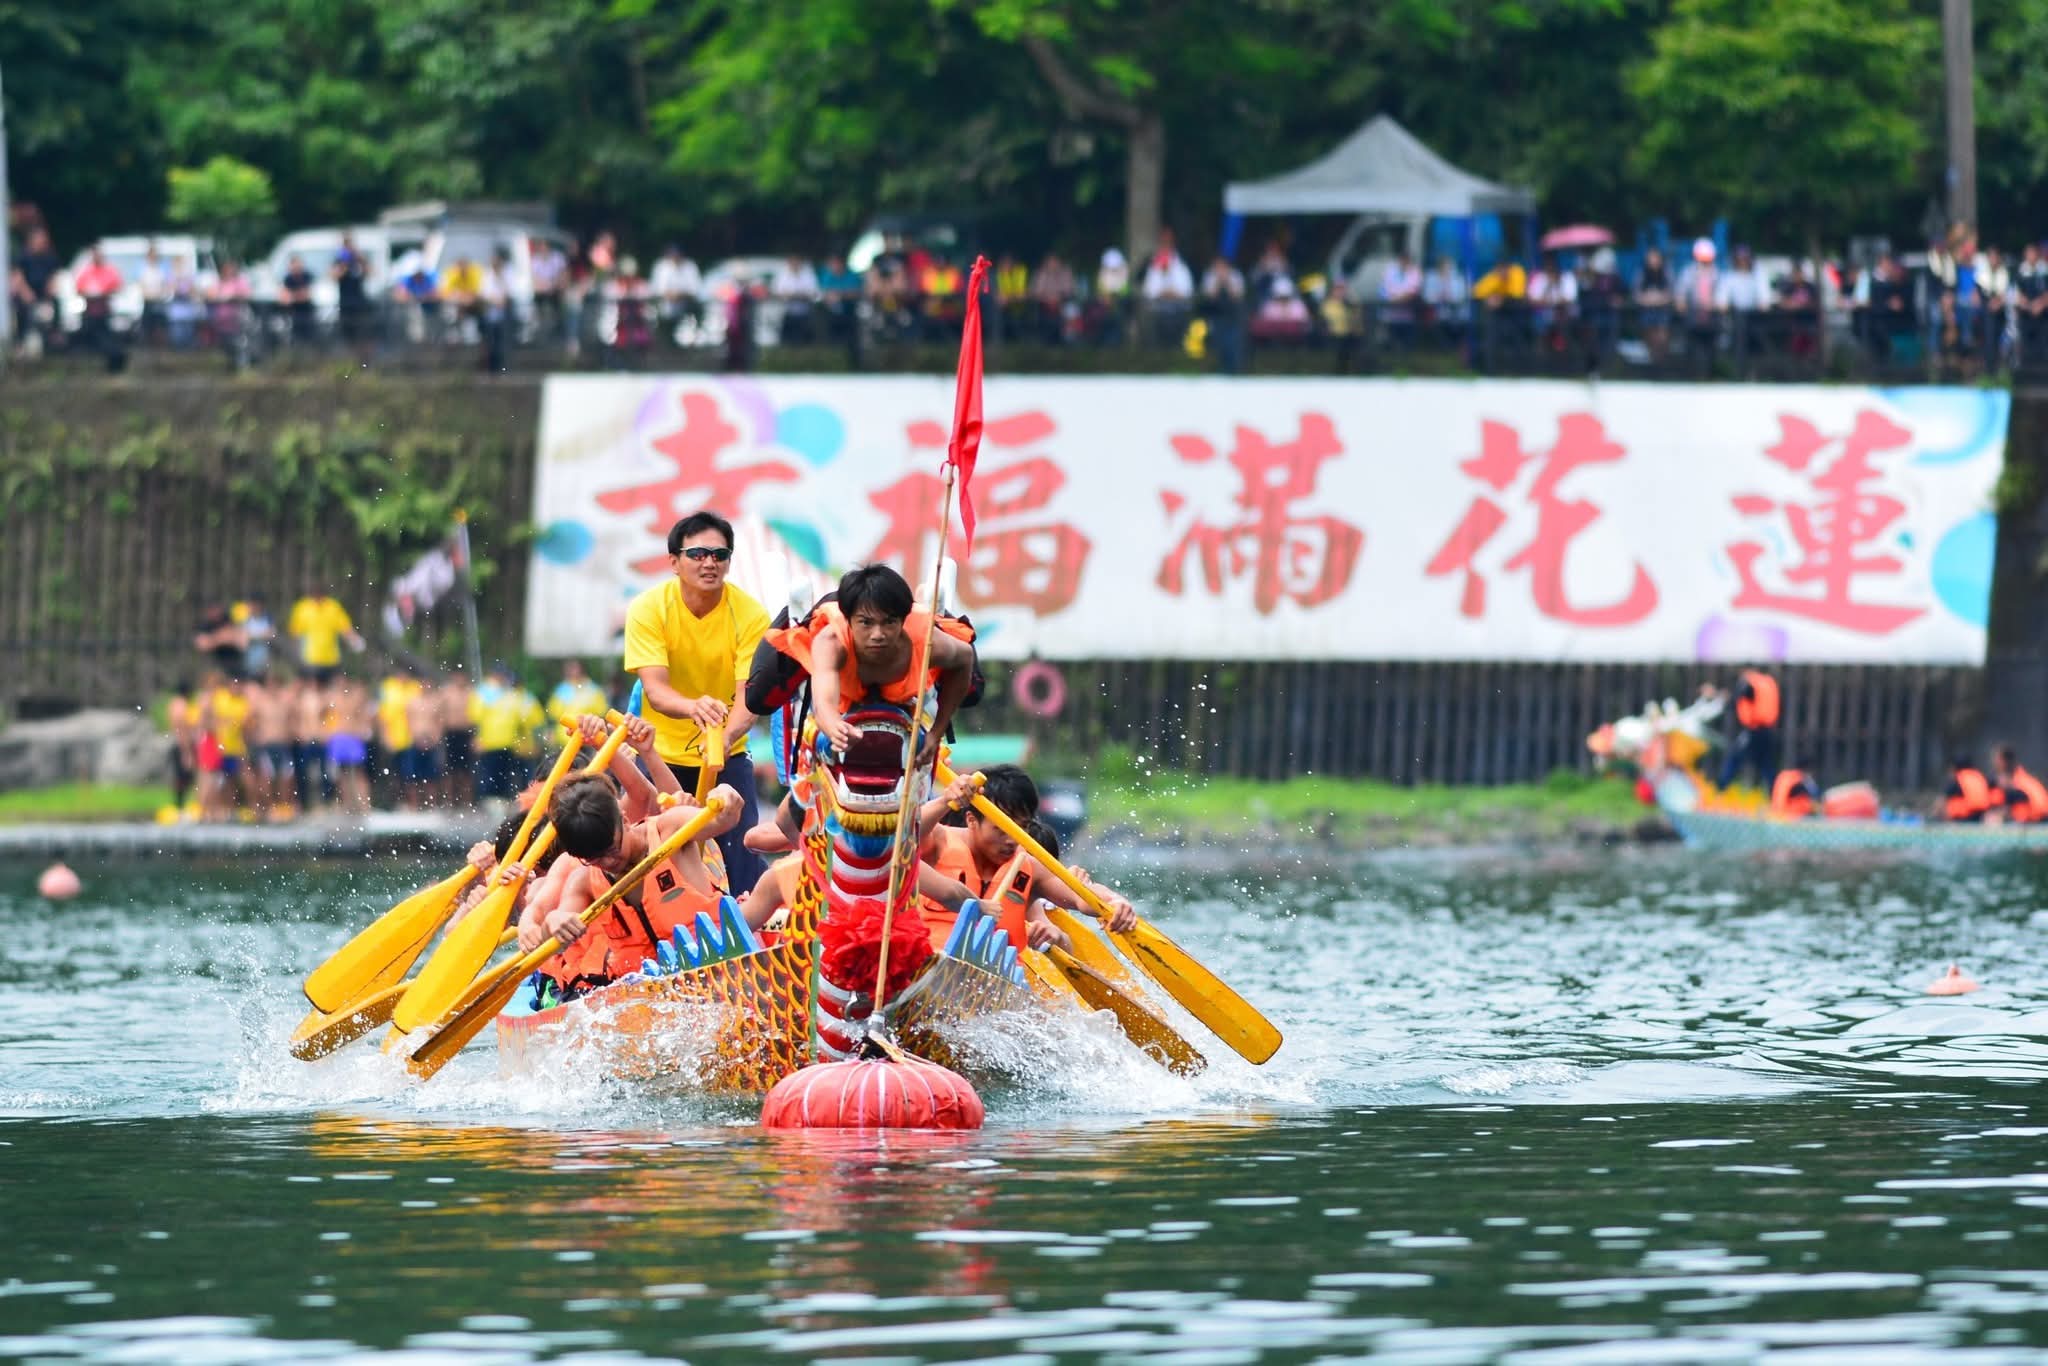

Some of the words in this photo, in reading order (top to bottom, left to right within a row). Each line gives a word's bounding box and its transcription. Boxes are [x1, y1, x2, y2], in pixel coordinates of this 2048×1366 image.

[596, 392, 1929, 635] 幸福滿花蓮
